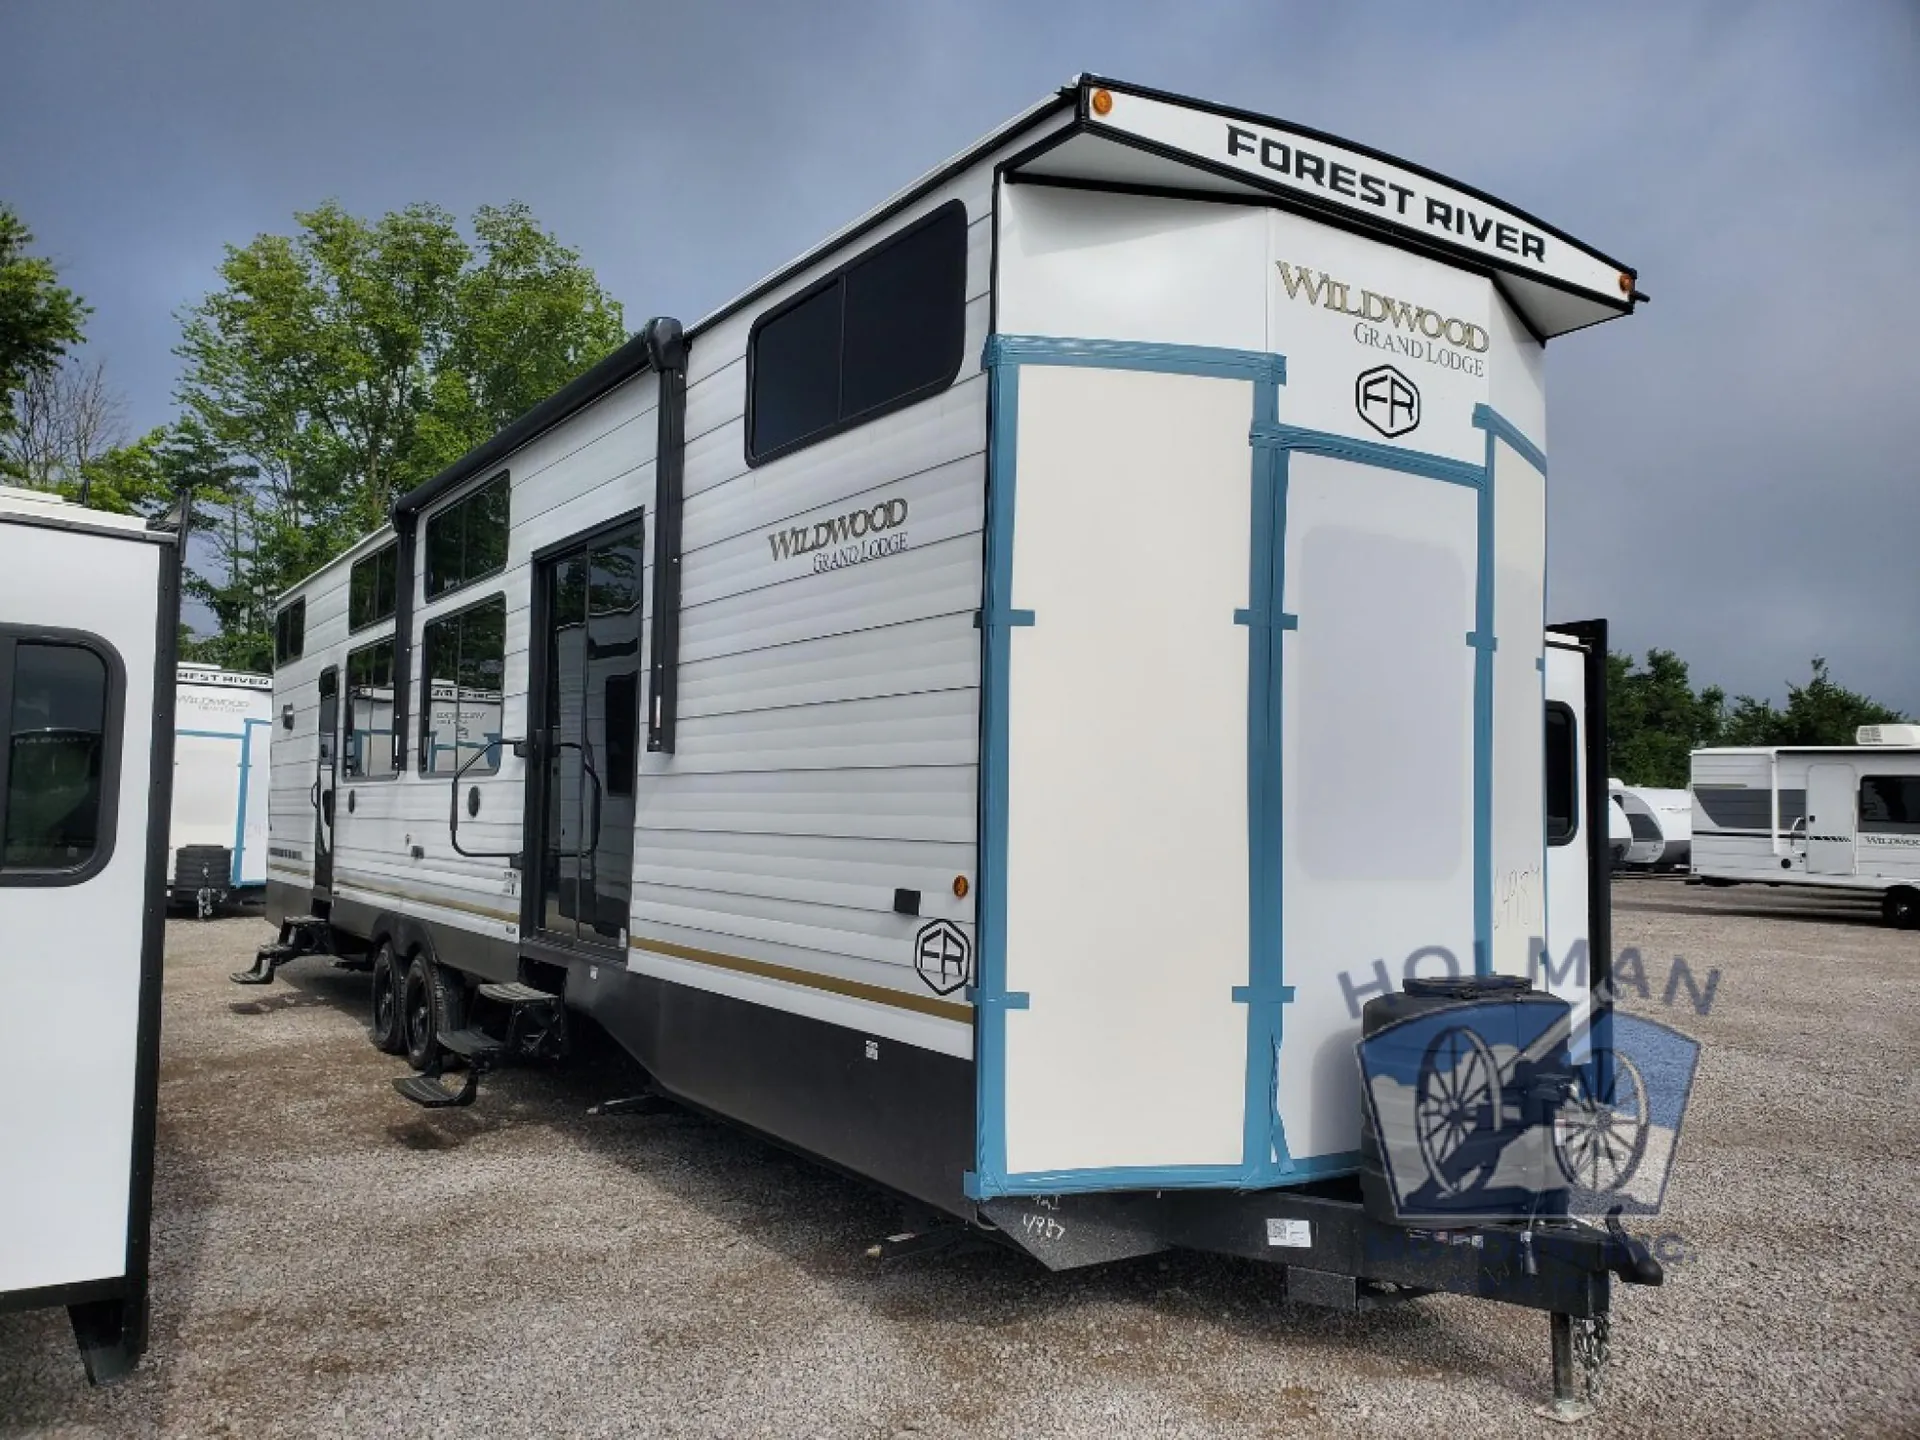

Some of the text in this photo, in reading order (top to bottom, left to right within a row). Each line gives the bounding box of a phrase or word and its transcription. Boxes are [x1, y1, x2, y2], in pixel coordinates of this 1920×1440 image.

[1226, 123, 1547, 264] FOREST RIVER
[1276, 260, 1490, 353] WILDWOOD
[1353, 321, 1485, 377] GRAND LODGE
[767, 497, 909, 562] WILDWOOD
[813, 531, 909, 574] GRAND LODGE
